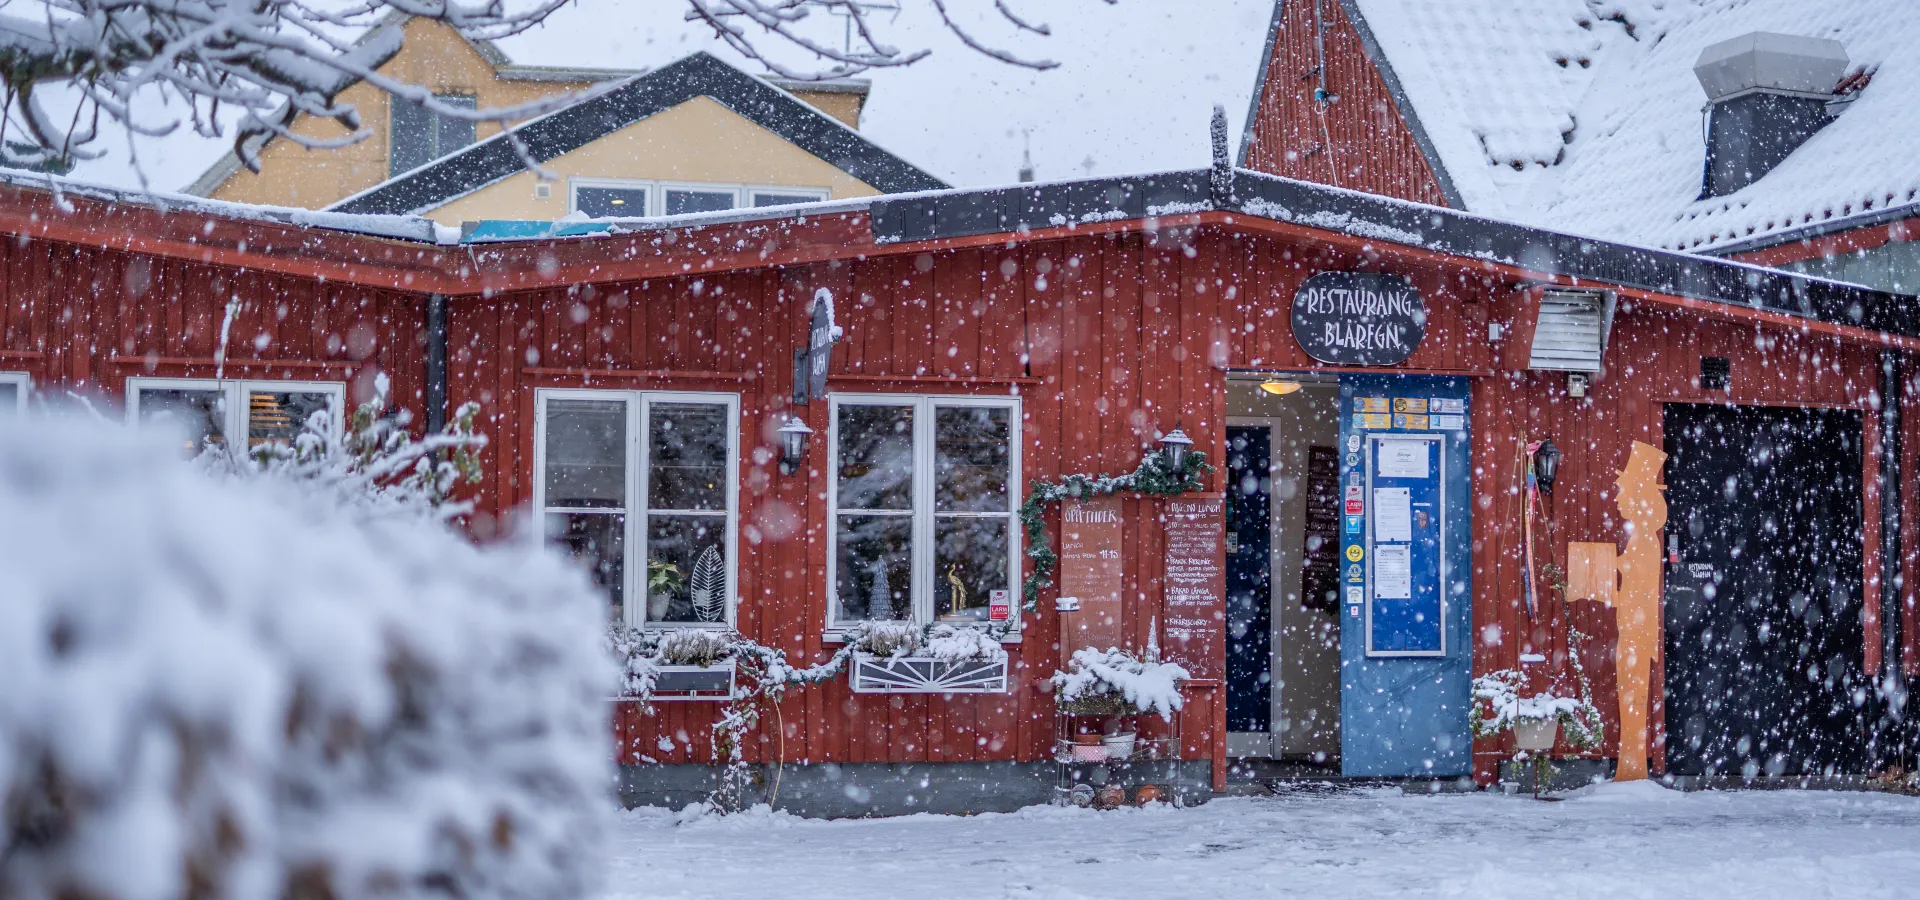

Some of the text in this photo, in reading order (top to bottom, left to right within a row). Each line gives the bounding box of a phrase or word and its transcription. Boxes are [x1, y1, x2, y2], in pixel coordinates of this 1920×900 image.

[1307, 287, 1412, 317] RESTAURANG
[1325, 319, 1401, 350] BLÅREGN
[1198, 504, 1221, 513] LUNCH
[1062, 542, 1084, 550] LUNCH
[1101, 549, 1119, 559] 11-15
